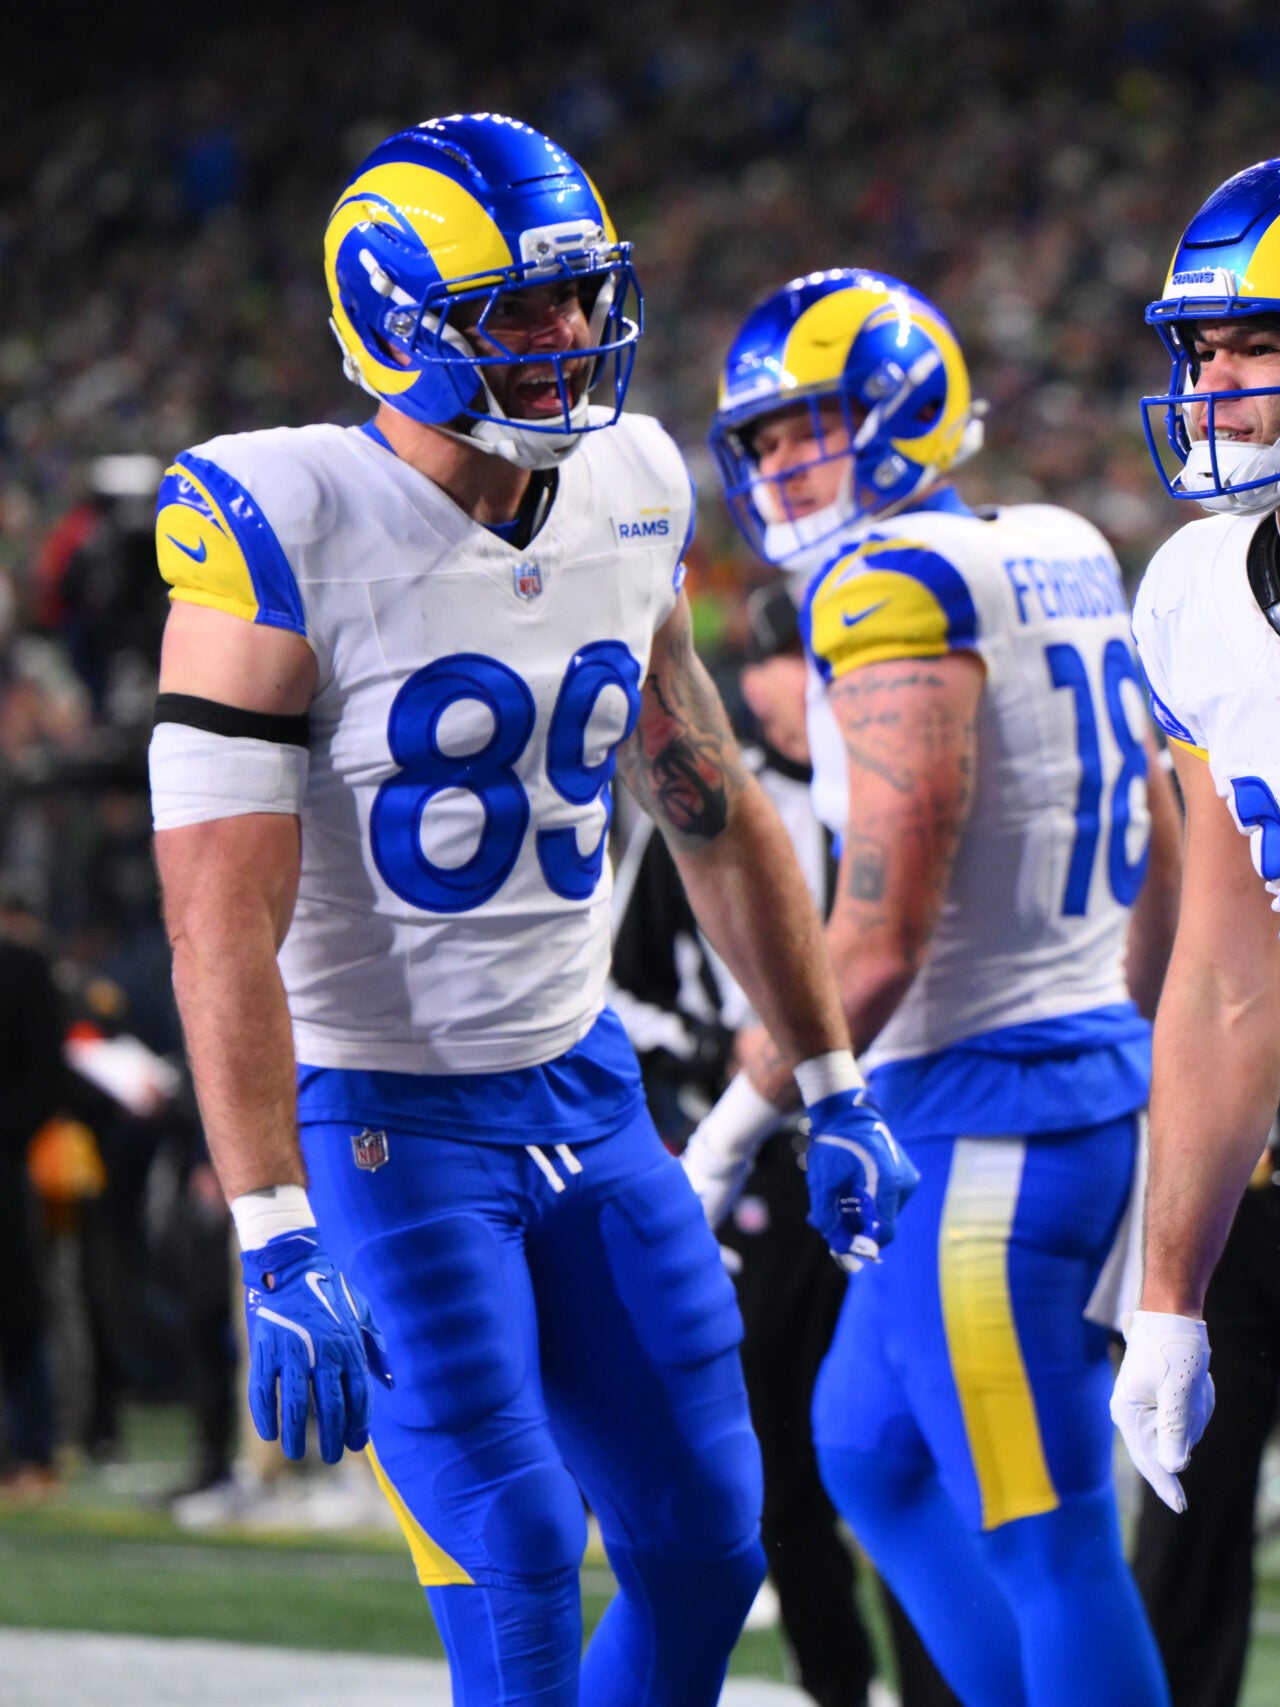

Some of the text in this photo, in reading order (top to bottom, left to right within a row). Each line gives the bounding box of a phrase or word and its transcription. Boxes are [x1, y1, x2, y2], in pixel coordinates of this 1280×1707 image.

[1172, 271, 1215, 285] RAMS
[618, 519, 669, 538] RAMS
[369, 639, 642, 914] 89
[1044, 638, 1149, 917] 18
